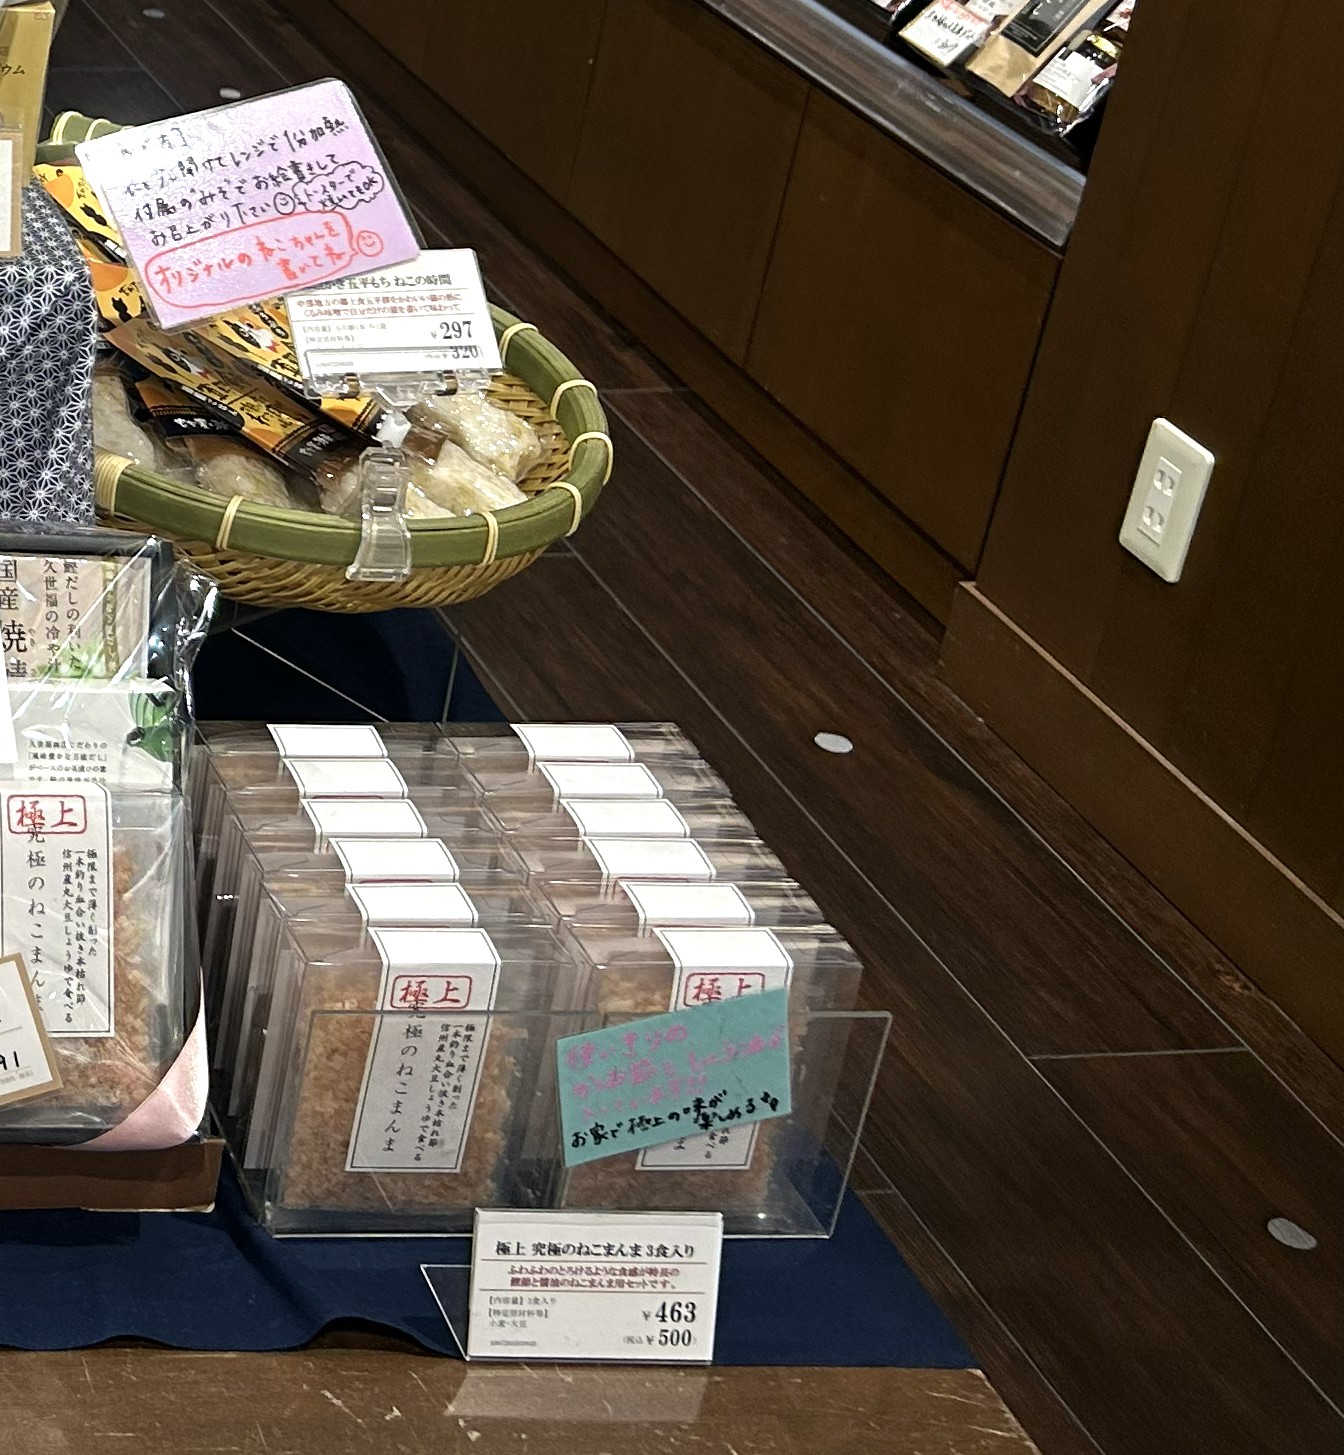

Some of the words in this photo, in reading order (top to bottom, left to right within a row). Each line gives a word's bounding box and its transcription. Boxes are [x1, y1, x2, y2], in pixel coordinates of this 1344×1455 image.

[15, 799, 78, 829] 極上
[398, 979, 461, 1006] 極上
[496, 1241, 525, 1256] 極上
[532, 1243, 642, 1257] 究極のねこまんま
[646, 1245, 695, 1258] 3食入り
